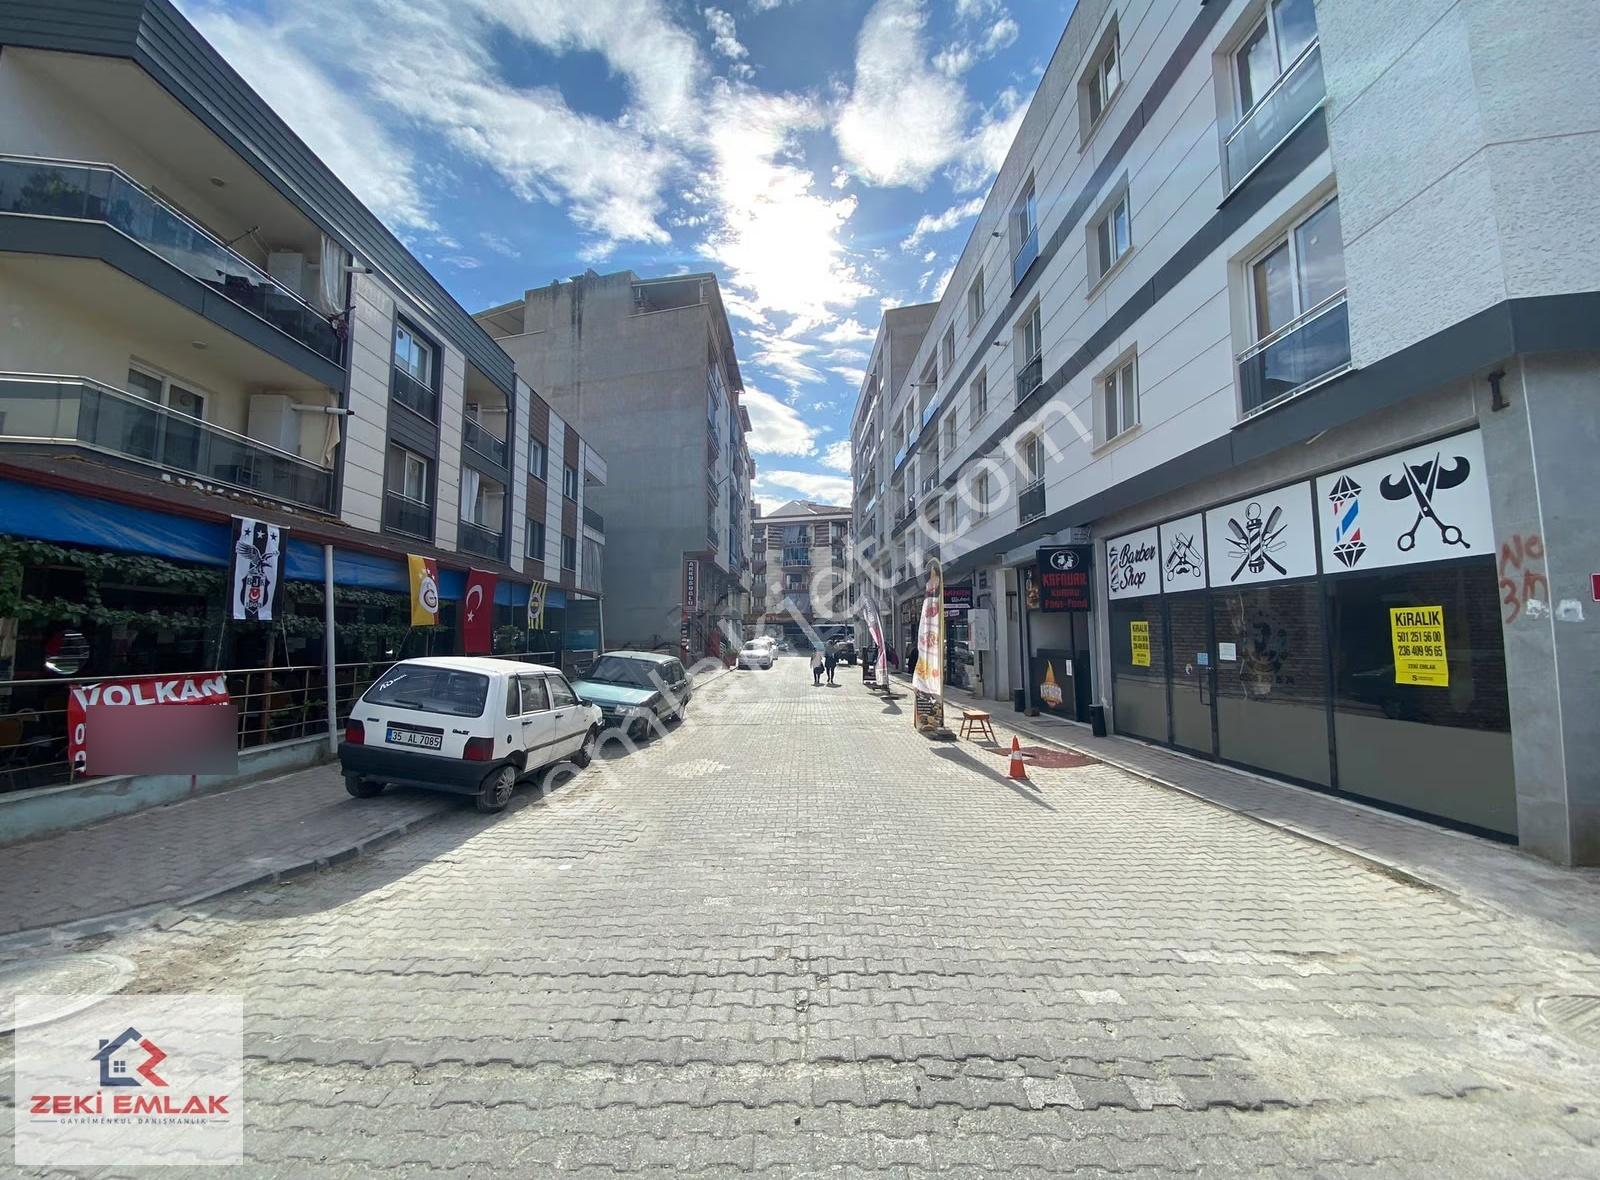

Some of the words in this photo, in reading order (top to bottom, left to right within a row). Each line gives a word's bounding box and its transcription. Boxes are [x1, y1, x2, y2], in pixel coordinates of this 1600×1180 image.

[1119, 542, 1156, 568] Barber
[1120, 565, 1146, 589] Shop
[1397, 631, 1409, 642] 501
[1410, 631, 1422, 642] 251
[1423, 631, 1432, 642] 56
[1433, 631, 1441, 642] 00
[1425, 646, 1433, 656] 95
[1434, 646, 1442, 656] 65
[73, 678, 228, 712] VOLKAN
[392, 731, 402, 741] 35
[407, 733, 418, 744] AL
[419, 735, 440, 747] 7085
